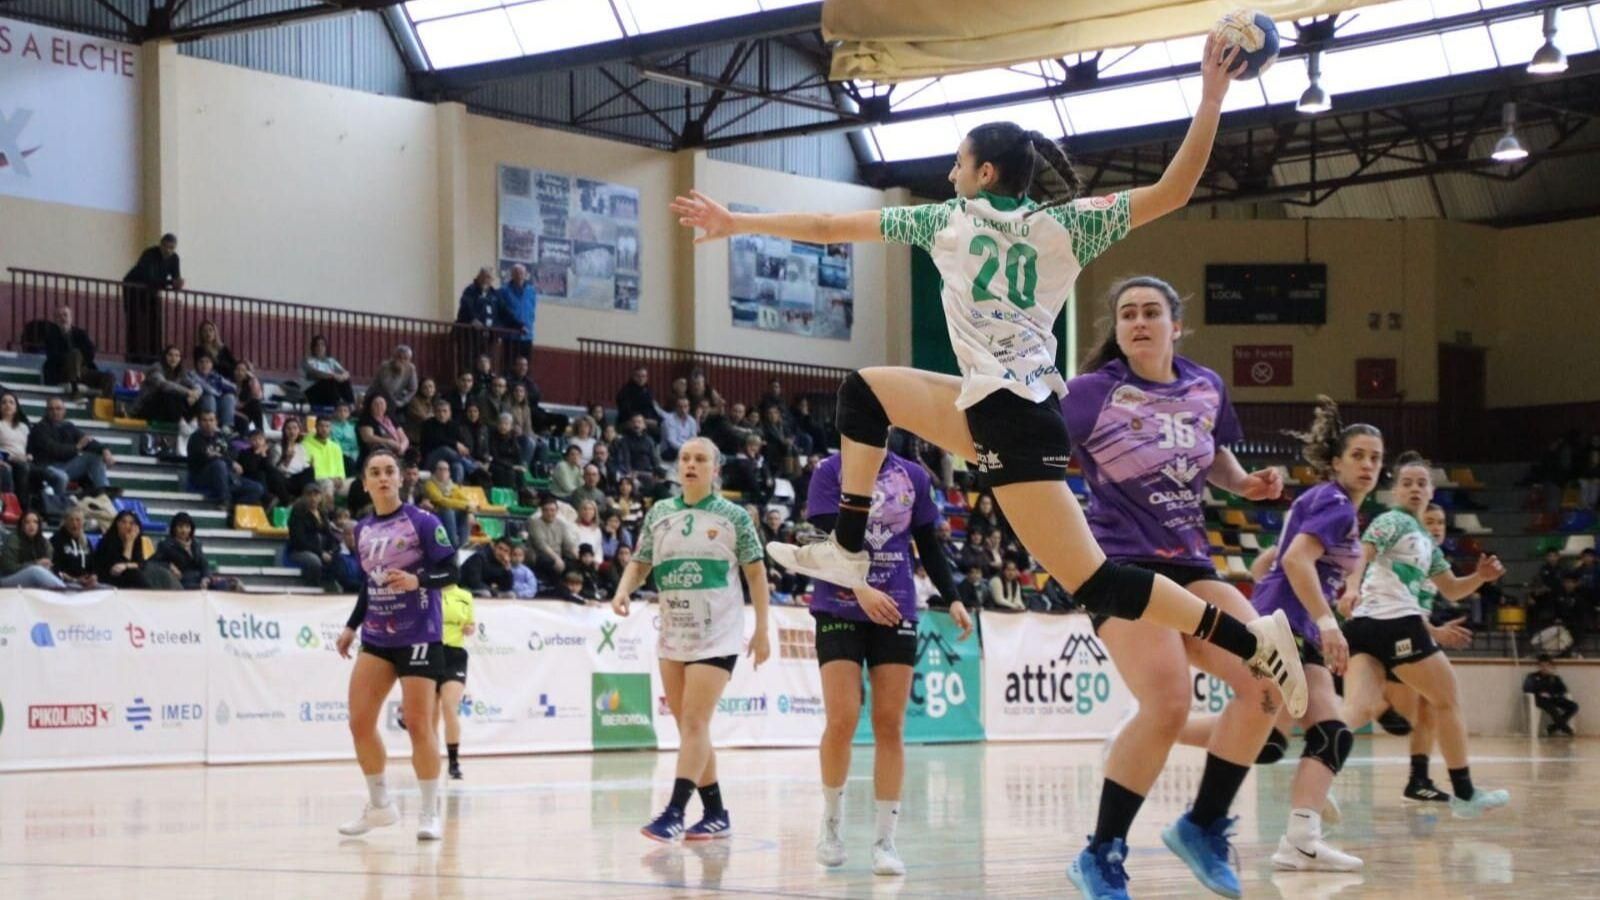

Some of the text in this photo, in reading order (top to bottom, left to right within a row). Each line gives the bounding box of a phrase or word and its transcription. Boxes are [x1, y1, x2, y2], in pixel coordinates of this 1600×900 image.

[0, 26, 134, 78] S A ELCHE
[969, 234, 1038, 310] 20
[1211, 290, 1244, 300] LOCAL
[1154, 411, 1196, 449] 36
[681, 513, 694, 537] 3
[369, 536, 389, 561] 77
[56, 623, 112, 642] affidea
[150, 630, 201, 645] teleelx
[216, 613, 281, 639] teika
[544, 633, 586, 646] urbaser
[411, 643, 430, 660] 77
[1005, 659, 1110, 715] atticgo
[31, 705, 95, 728] PIKOLINOS
[161, 704, 203, 720] IMED
